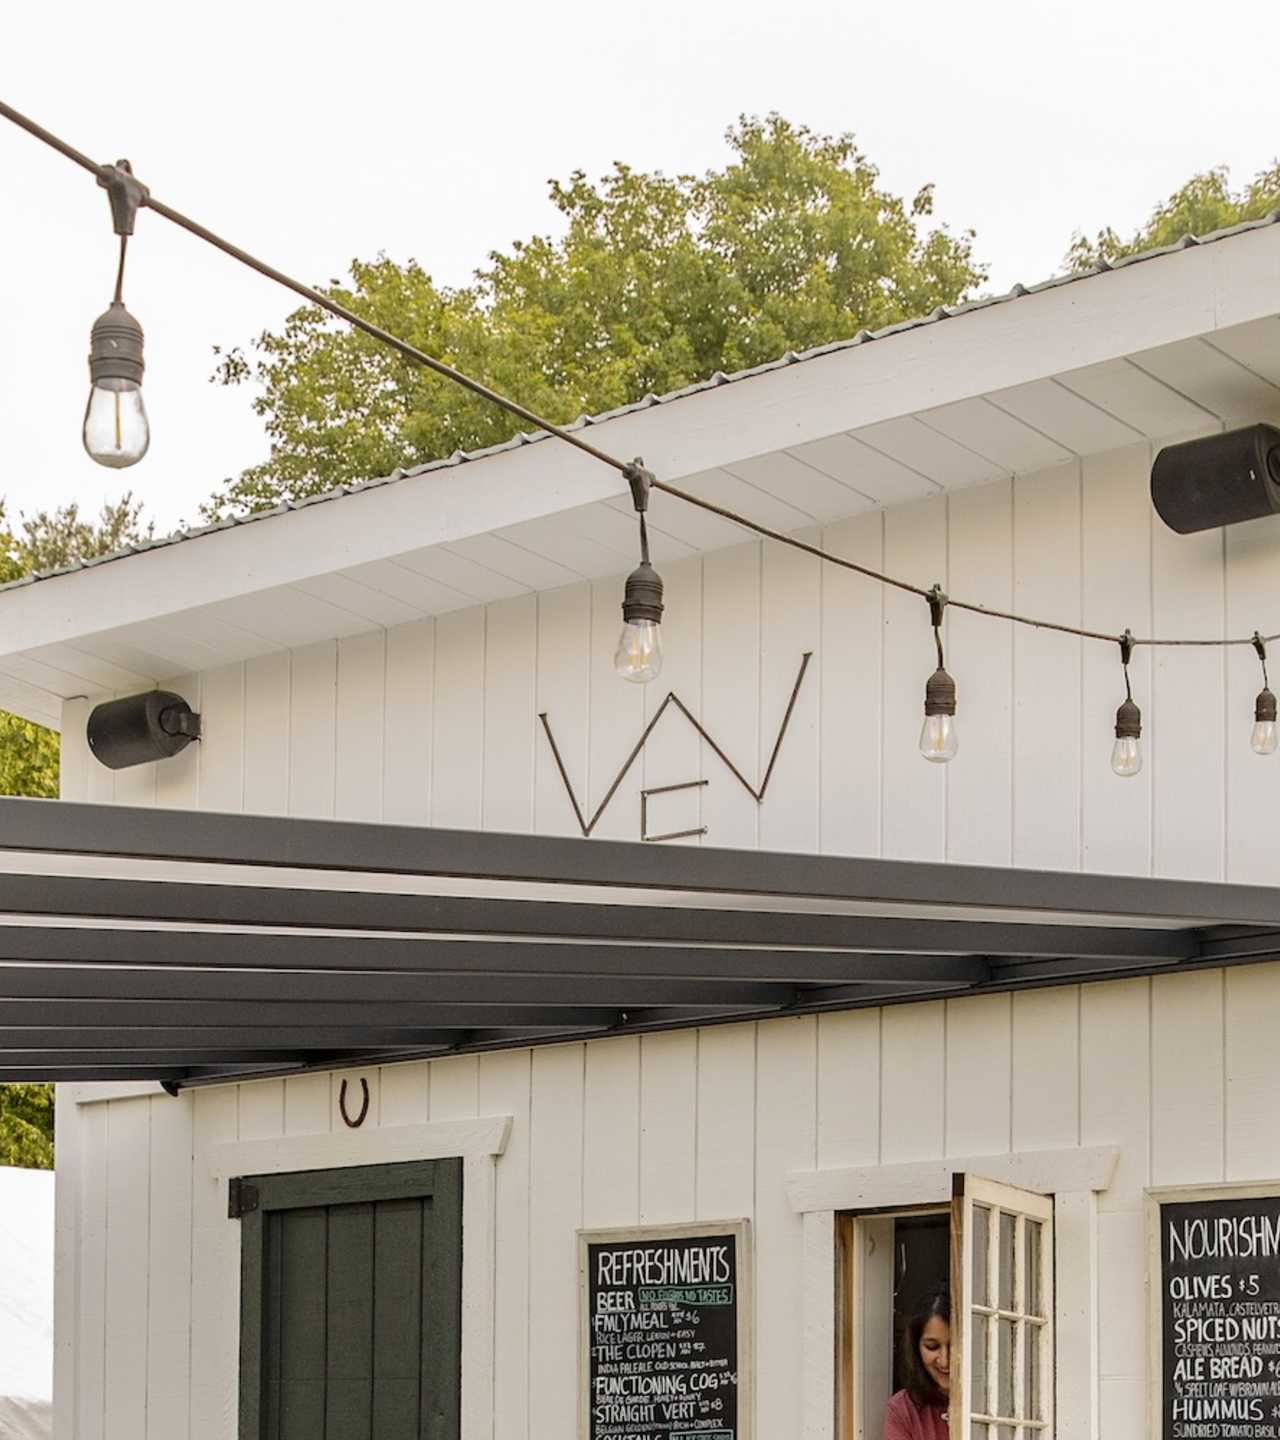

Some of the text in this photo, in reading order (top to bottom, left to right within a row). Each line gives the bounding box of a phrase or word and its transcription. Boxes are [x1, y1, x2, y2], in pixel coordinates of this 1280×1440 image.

[597, 1246, 731, 1286] REFRESHMENTS
[1170, 1274, 1260, 1300] OLIVES $5
[596, 1290, 636, 1312] BEER
[1174, 1317, 1240, 1343] SPICED
[596, 1344, 624, 1362] THE
[626, 1342, 676, 1361] CLOPEN
[1173, 1357, 1205, 1381] ALE
[1209, 1356, 1264, 1379] BREAD
[596, 1374, 687, 1396] FUNCTIONING
[690, 1372, 718, 1390] COG
[596, 1403, 657, 1424] STRAIGHT
[661, 1401, 697, 1421] VERT
[1172, 1399, 1264, 1421] HUMMUS
[1172, 1422, 1220, 1438] SUNDRIED
